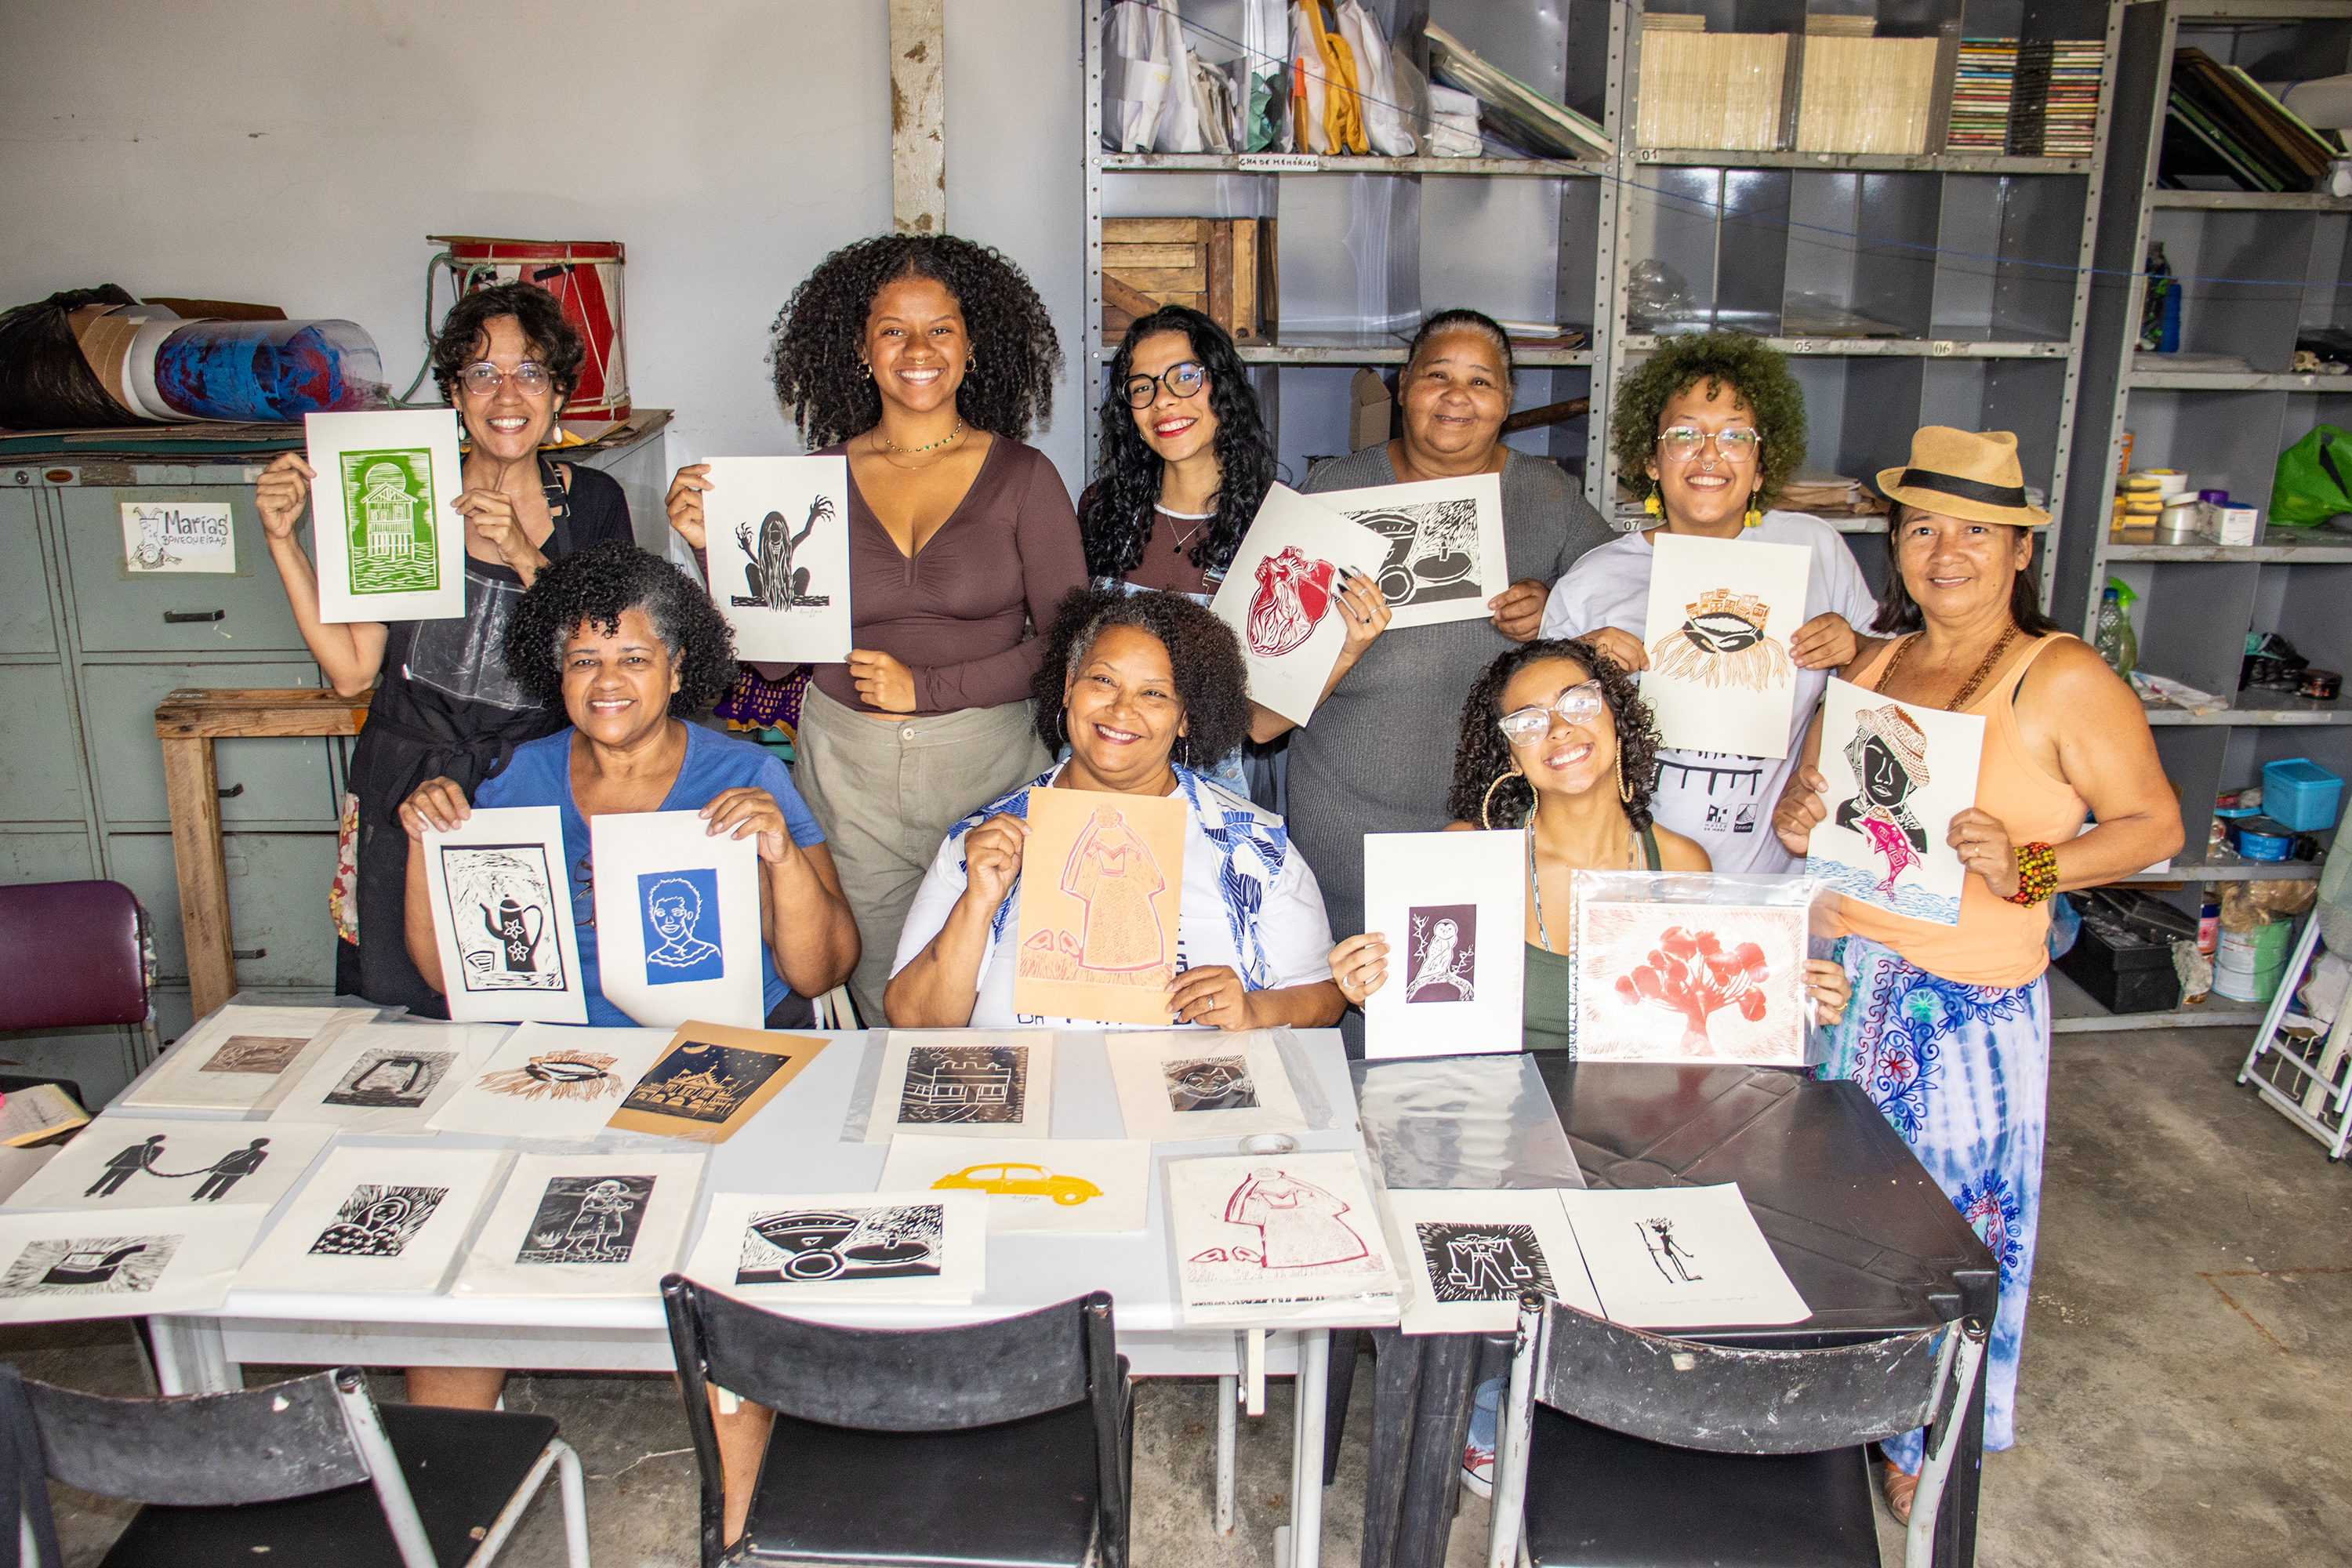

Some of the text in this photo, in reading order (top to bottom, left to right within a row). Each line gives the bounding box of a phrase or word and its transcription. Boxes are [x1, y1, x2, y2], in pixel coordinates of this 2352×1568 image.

[1642, 149, 1657, 161] 01
[1795, 342, 1812, 352] 05
[1935, 343, 1951, 354] 06
[1624, 520, 1640, 531] 07
